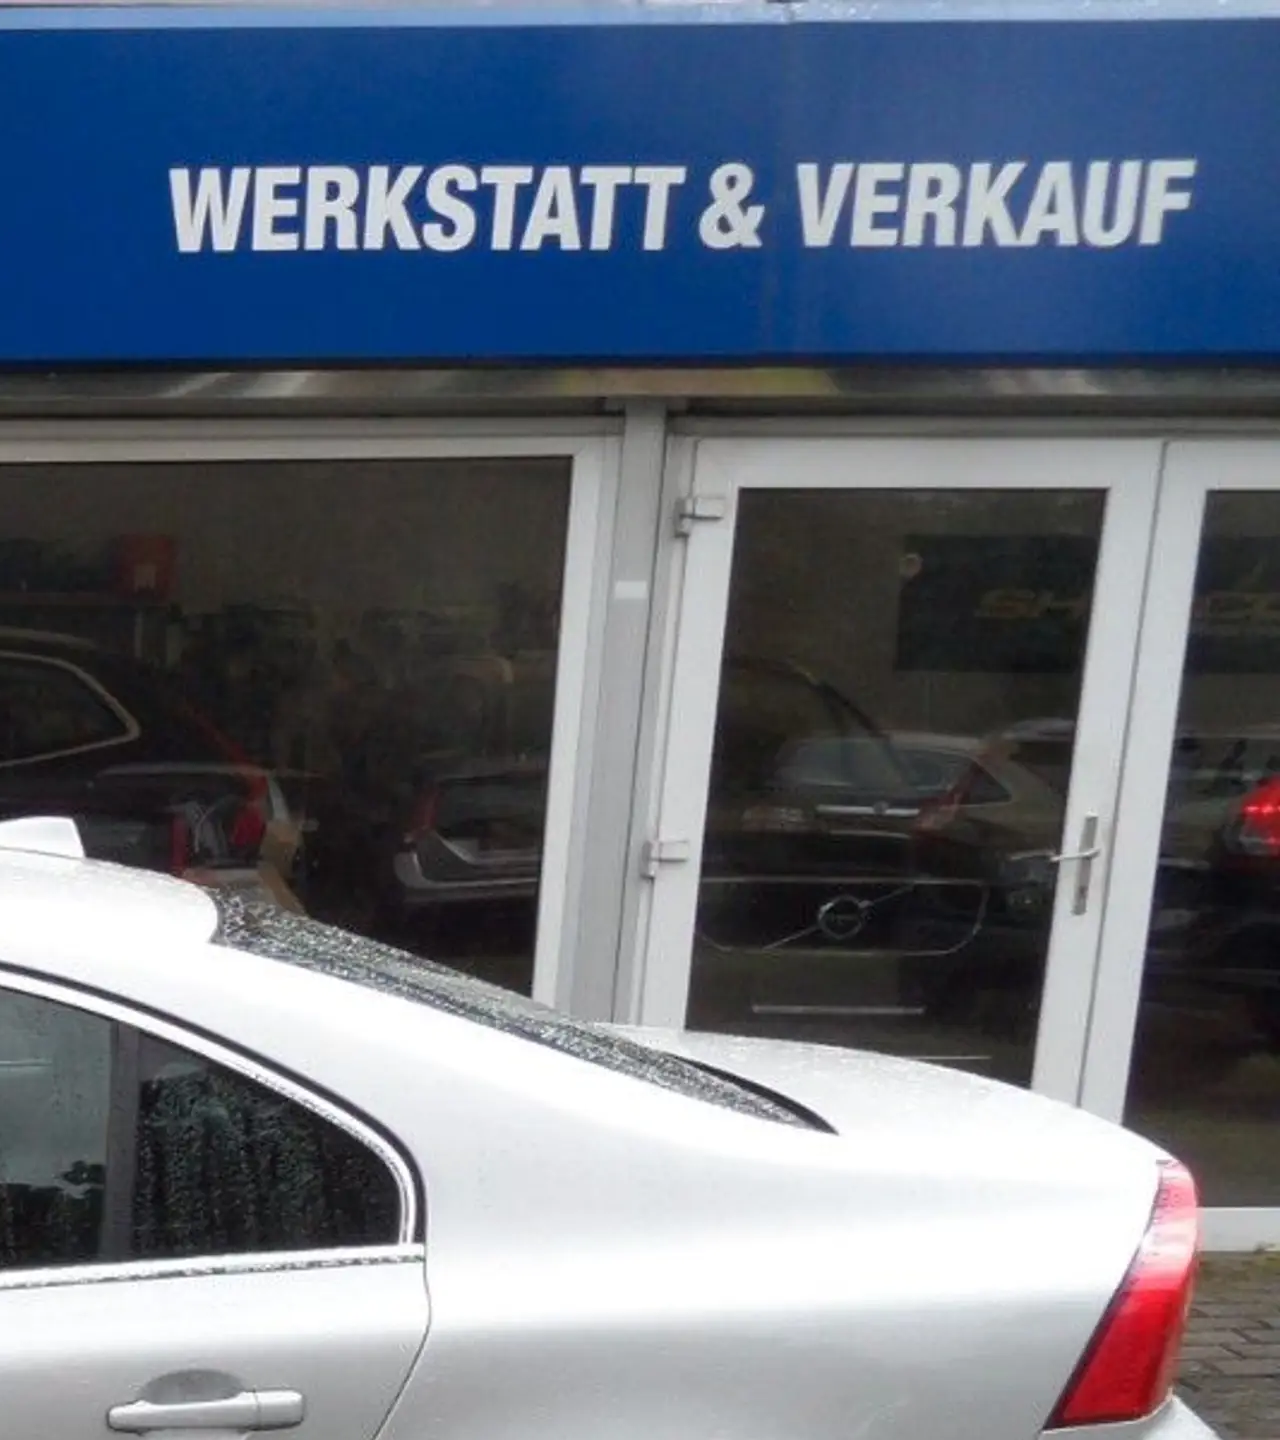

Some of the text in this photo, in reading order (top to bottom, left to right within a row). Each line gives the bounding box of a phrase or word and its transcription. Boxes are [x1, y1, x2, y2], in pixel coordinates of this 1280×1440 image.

[169, 160, 1198, 253] WERKSTATT & VERKAUF
